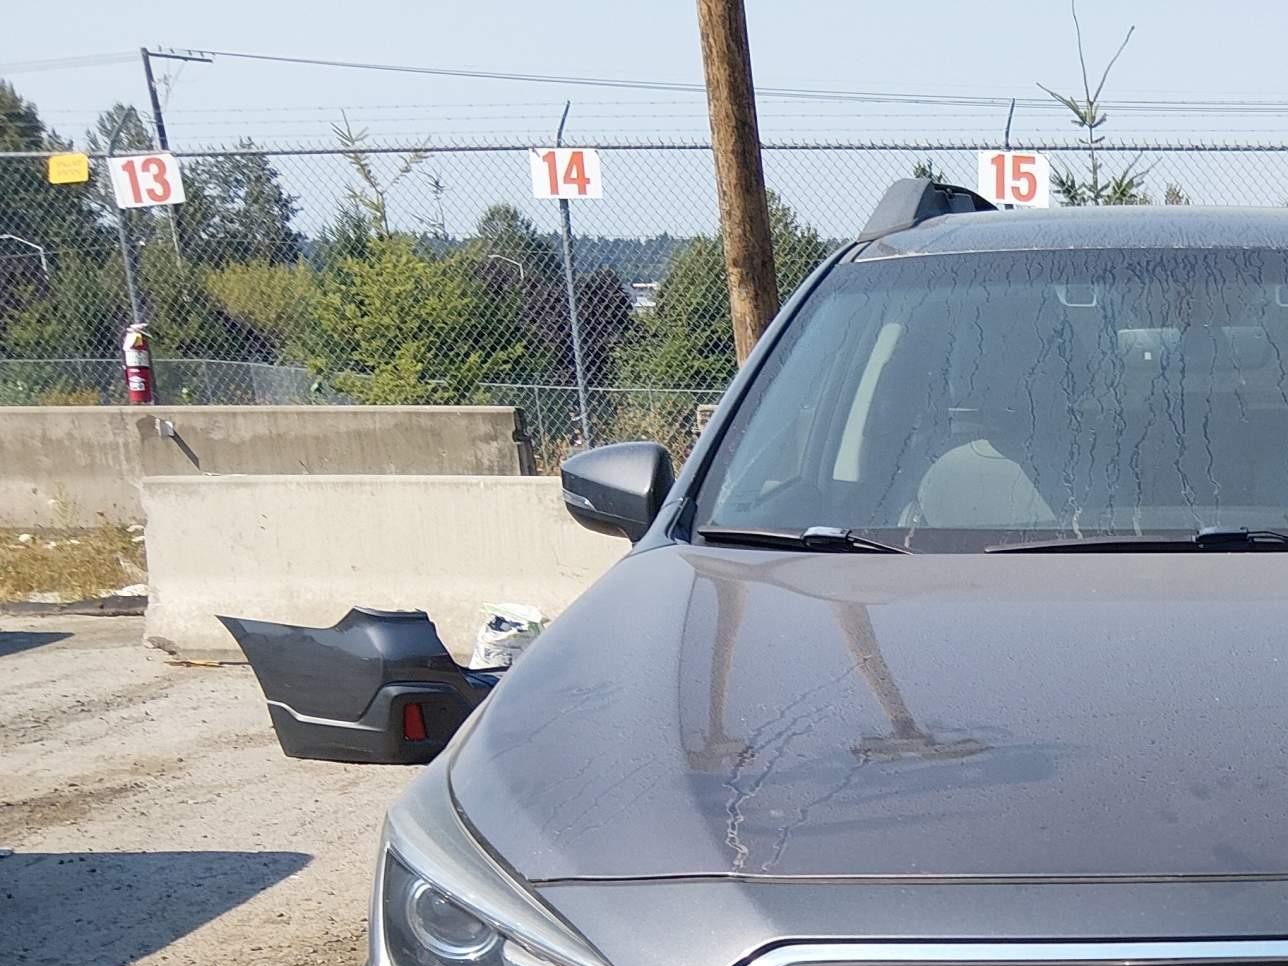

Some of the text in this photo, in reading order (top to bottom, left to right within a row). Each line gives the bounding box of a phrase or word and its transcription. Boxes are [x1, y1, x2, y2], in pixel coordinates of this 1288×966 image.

[121, 157, 171, 203] 13
[543, 151, 589, 194] 14
[990, 154, 1037, 202] 15
